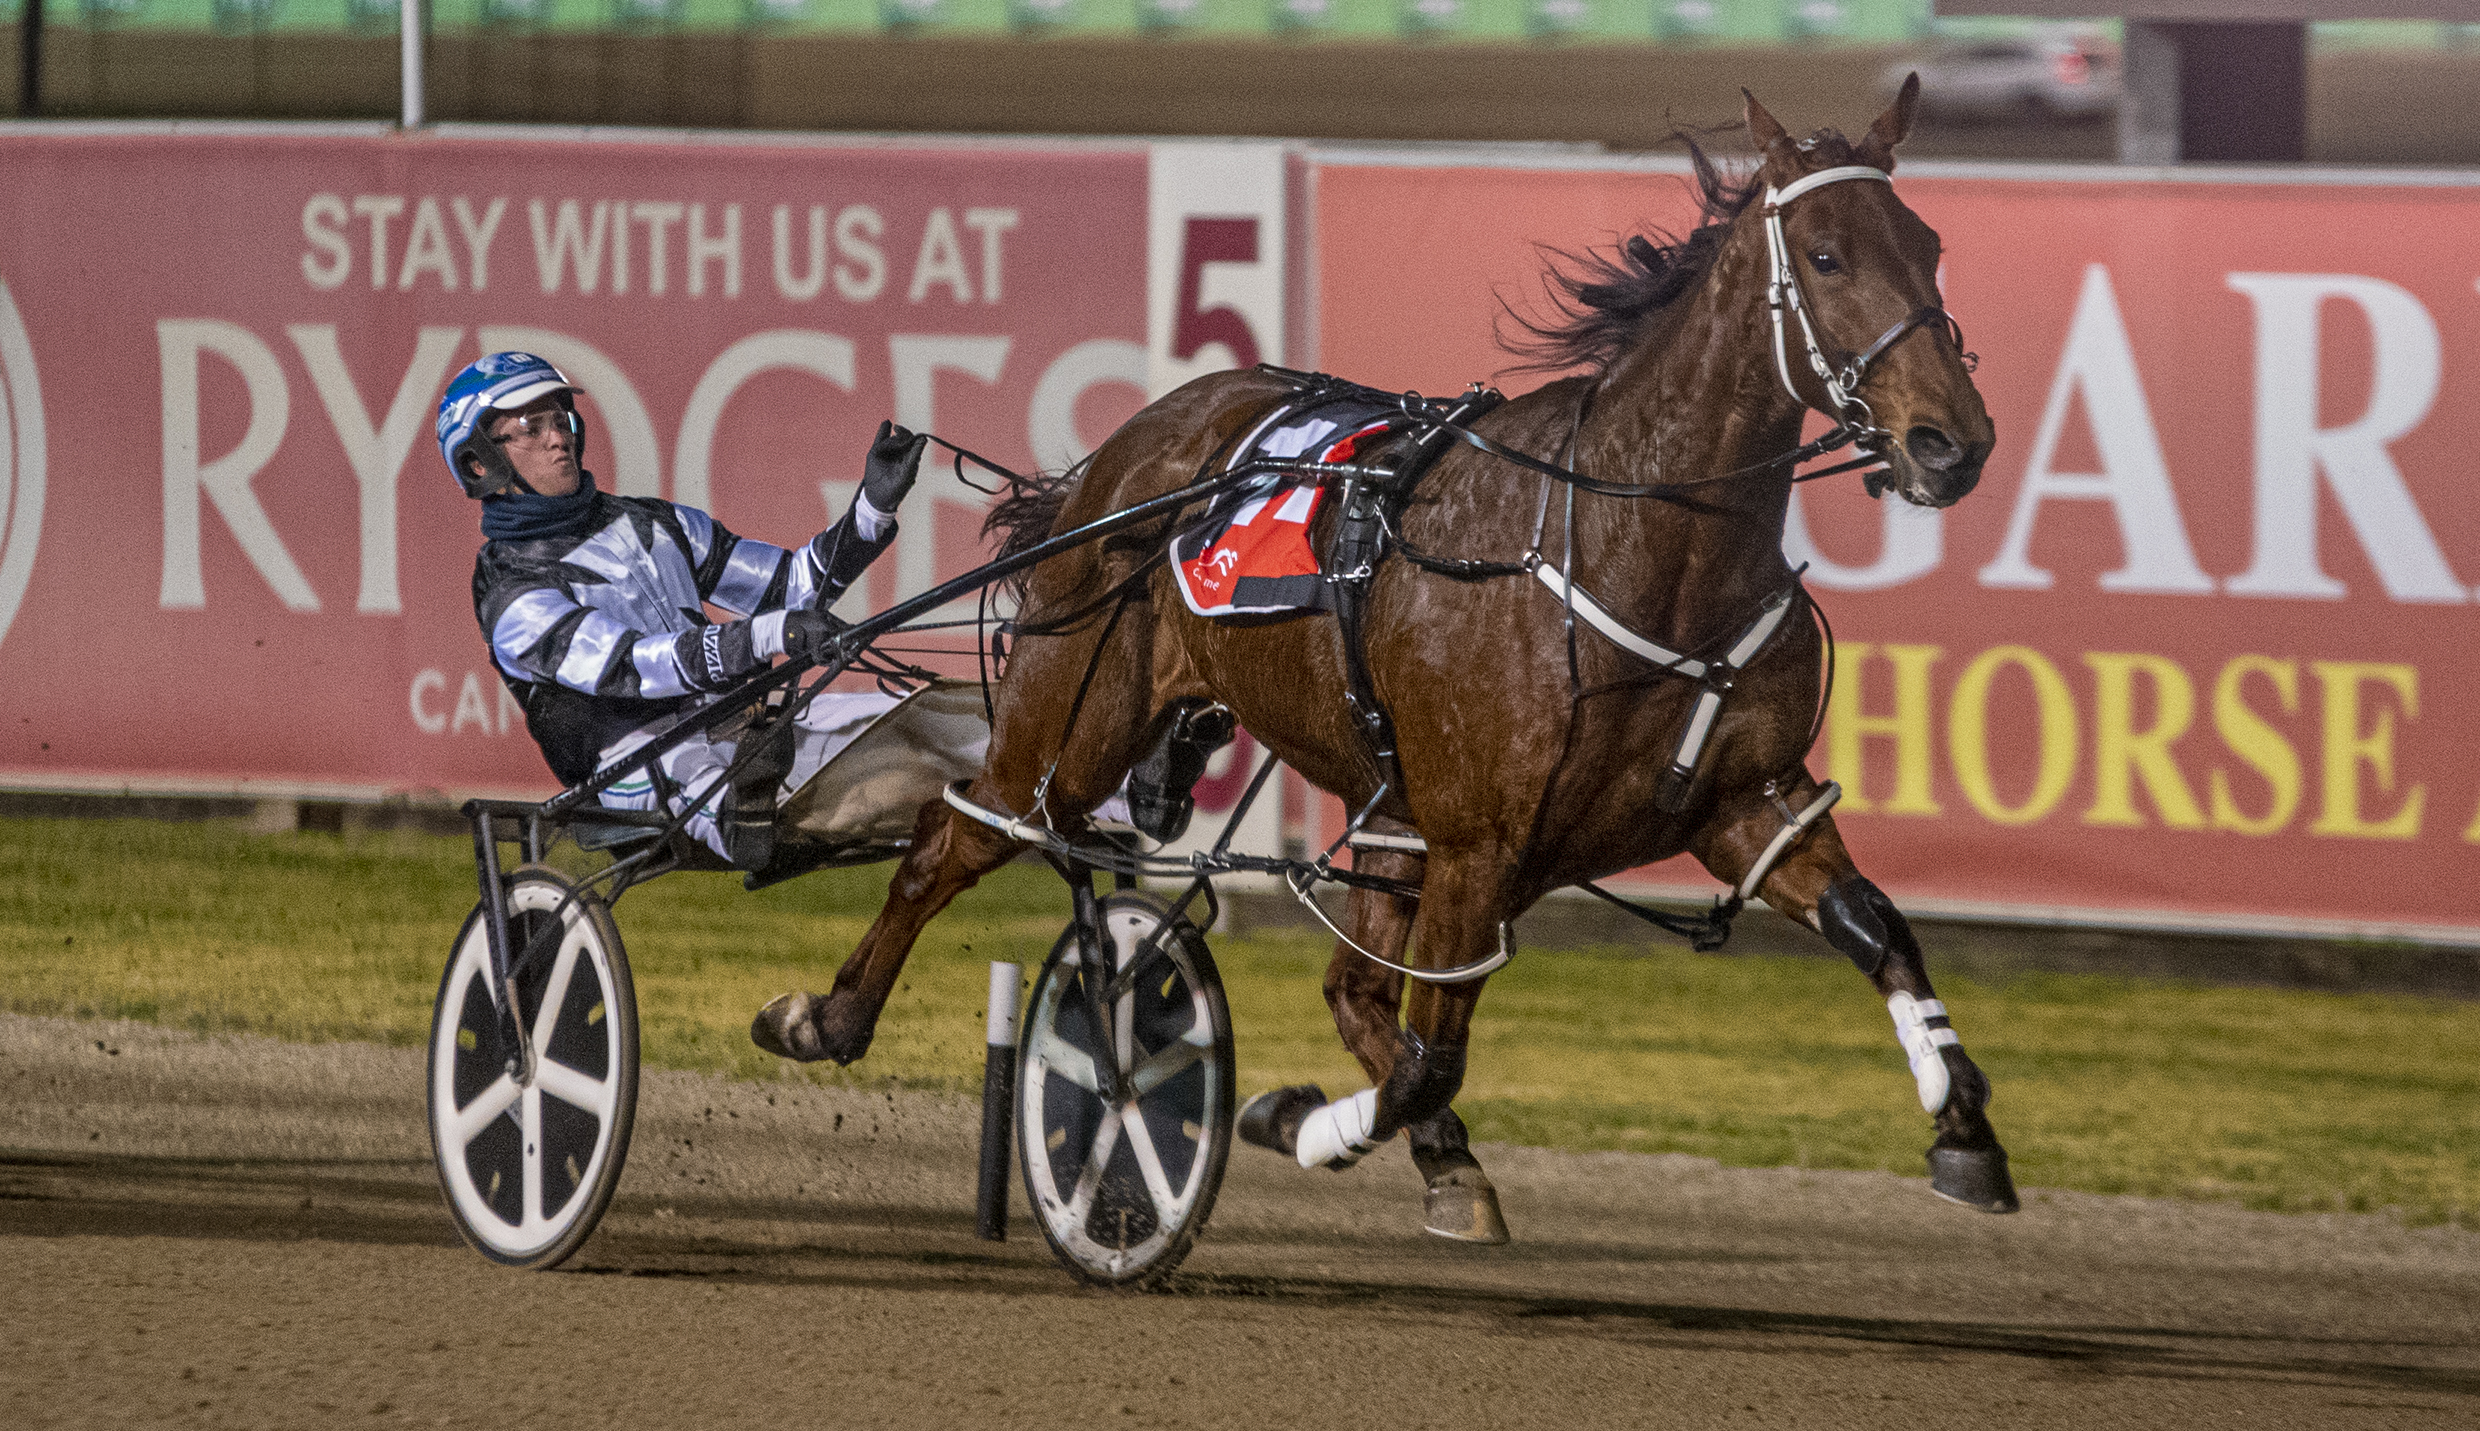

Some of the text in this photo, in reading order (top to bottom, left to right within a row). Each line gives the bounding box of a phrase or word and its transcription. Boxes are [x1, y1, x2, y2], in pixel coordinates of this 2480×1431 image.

[302, 194, 1019, 303] STAY WITH US AT
[1170, 216, 1262, 374] 5
[1822, 641, 2427, 842] HORSE
